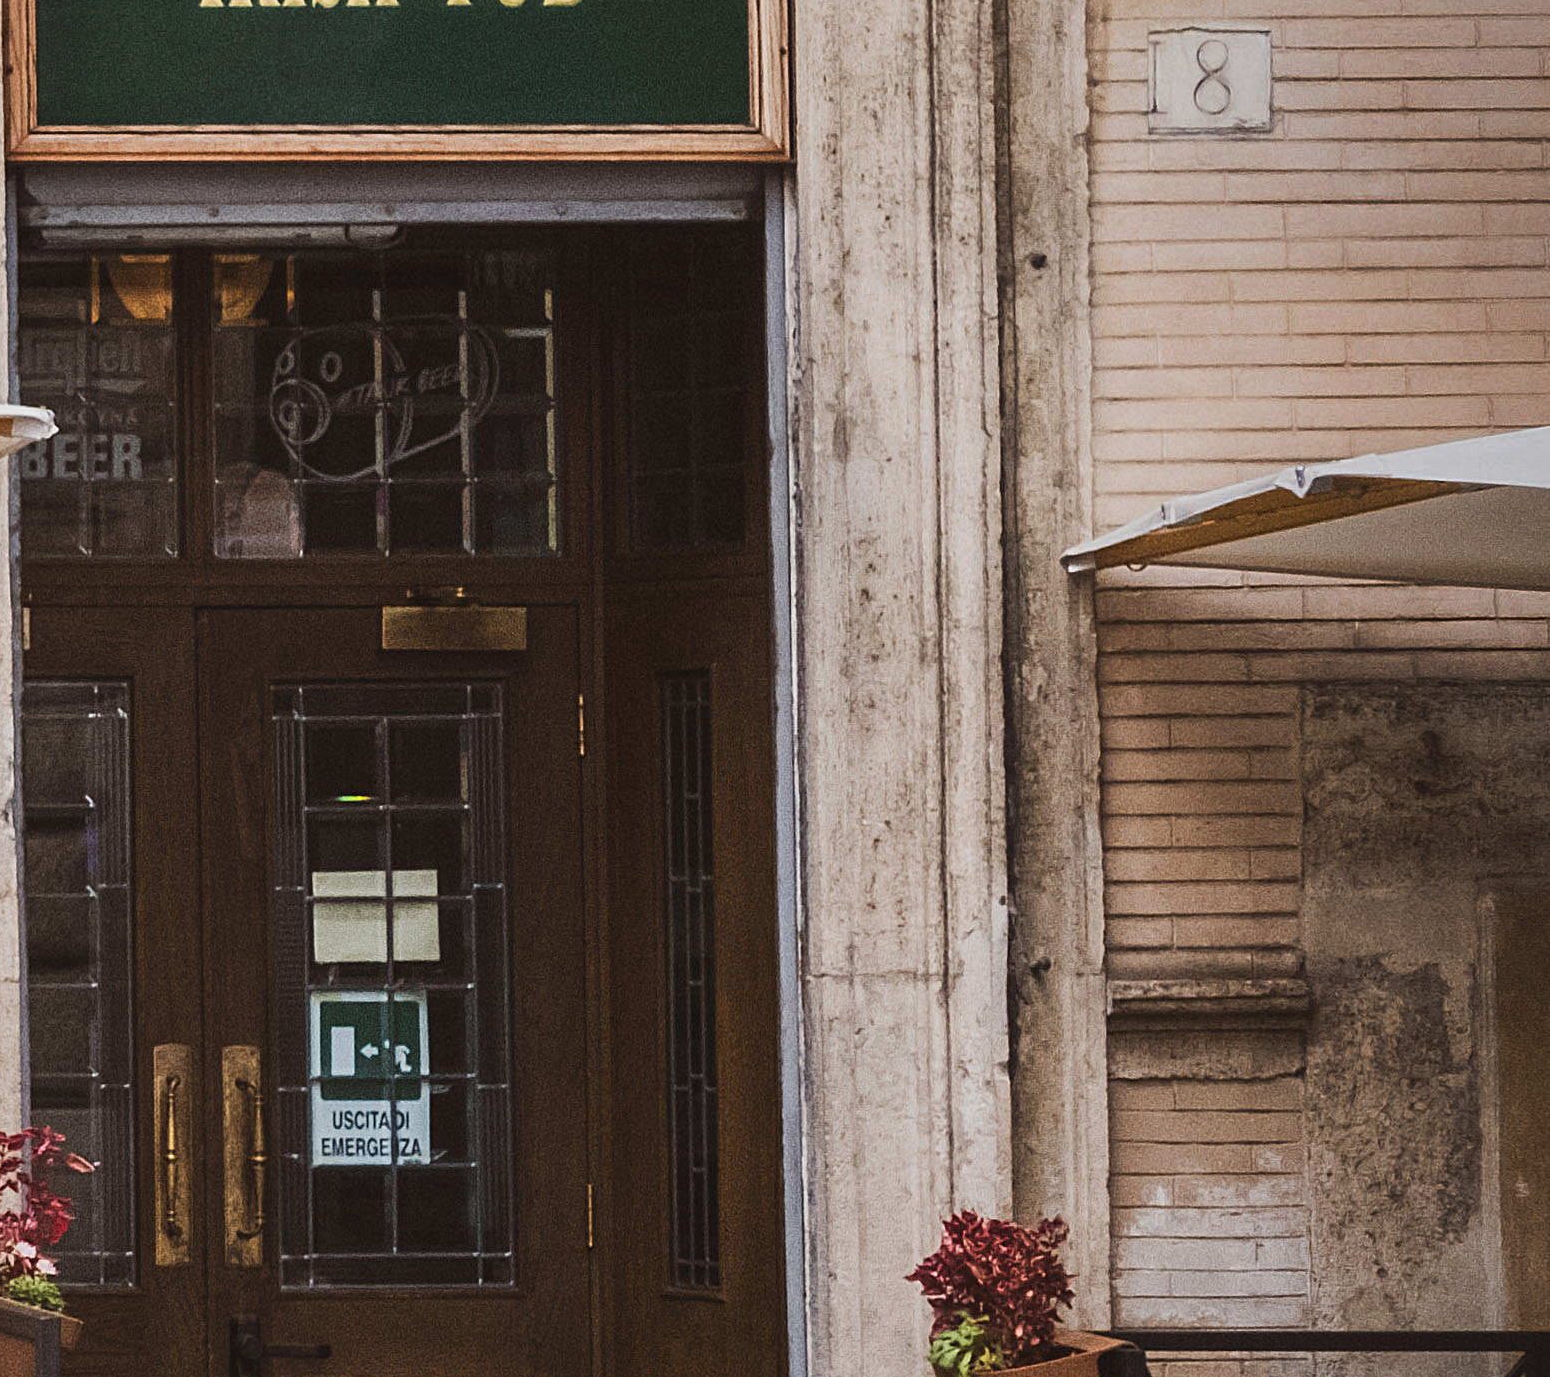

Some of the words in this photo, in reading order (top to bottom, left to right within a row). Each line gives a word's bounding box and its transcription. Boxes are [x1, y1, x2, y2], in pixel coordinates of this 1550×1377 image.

[21, 433, 143, 480] BEER
[332, 1110, 392, 1130] USCITA
[394, 1110, 410, 1130] DI
[321, 1137, 422, 1157] EMERGEZA
